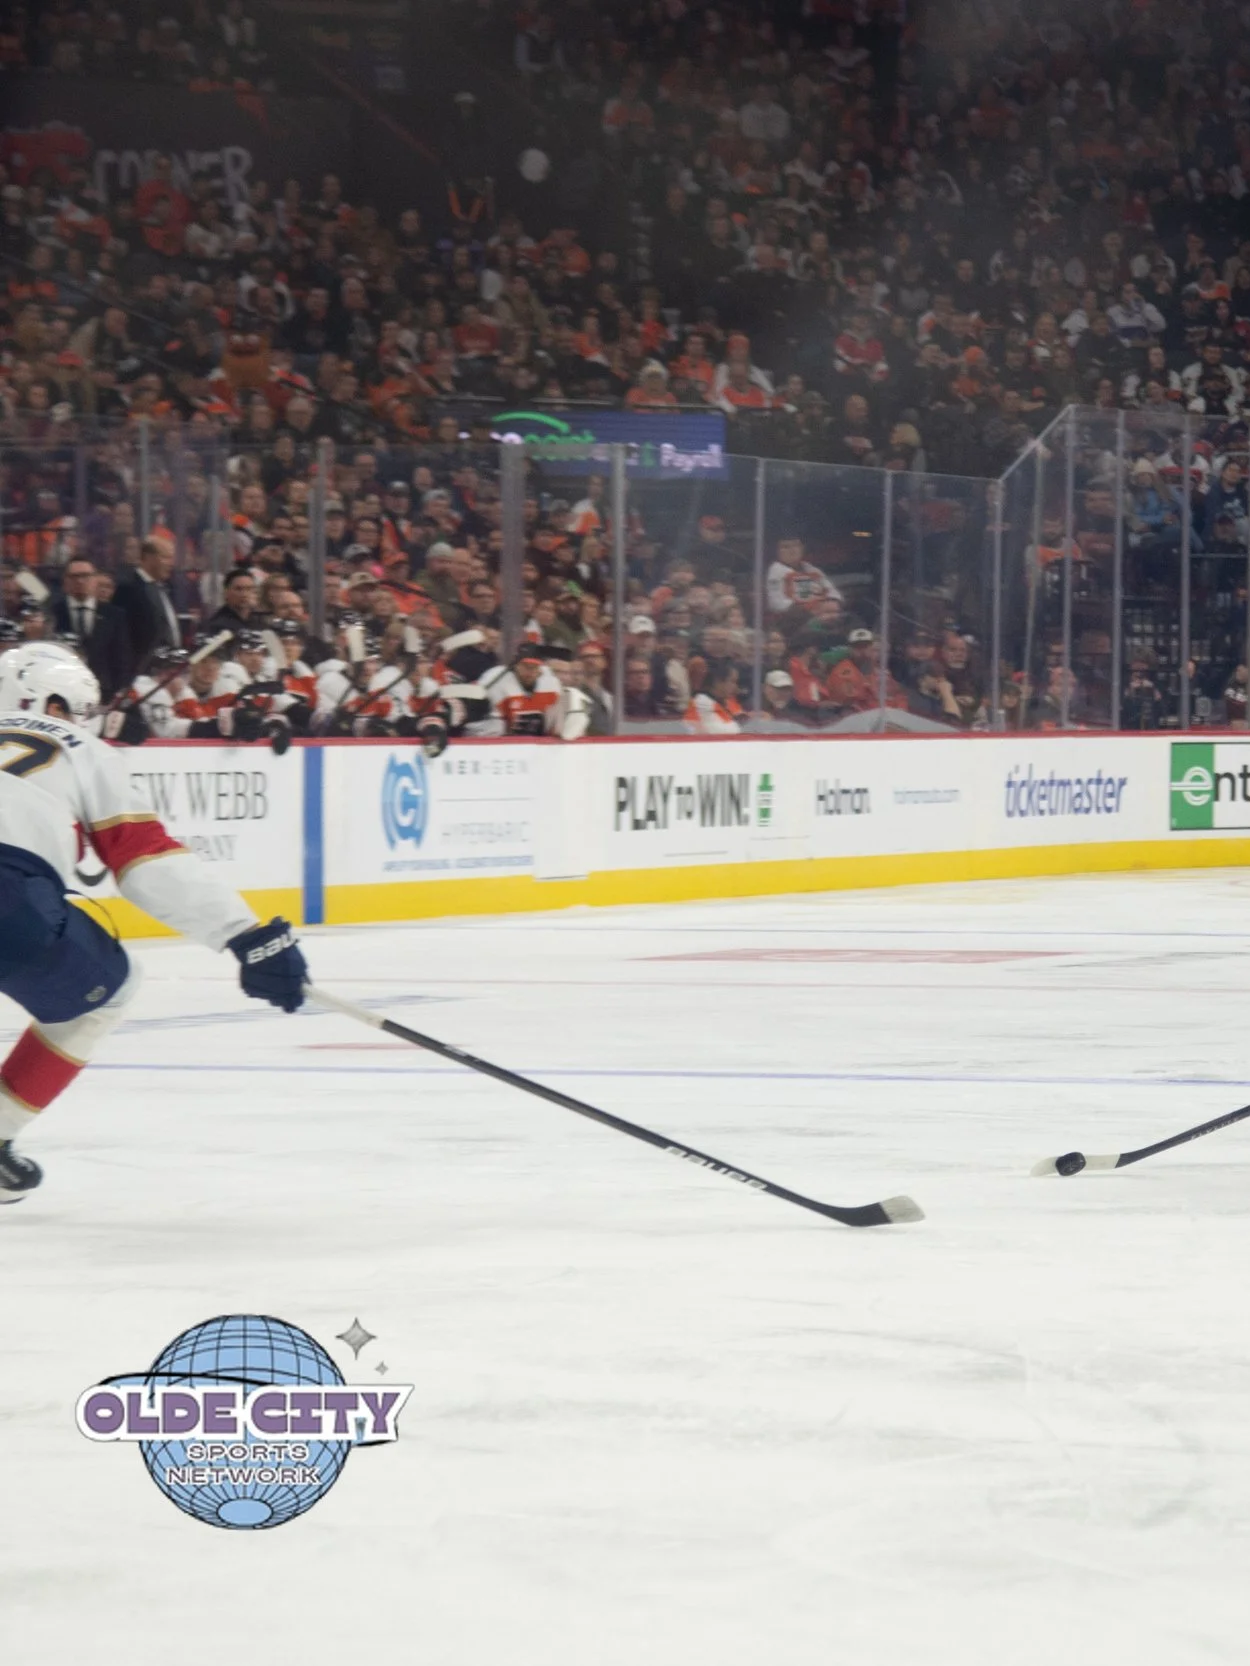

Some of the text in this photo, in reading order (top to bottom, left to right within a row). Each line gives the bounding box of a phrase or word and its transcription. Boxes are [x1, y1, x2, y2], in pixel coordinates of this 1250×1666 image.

[184, 770, 269, 821] WEBB
[614, 774, 675, 832] PLAY
[696, 772, 751, 828] WIN!
[816, 778, 872, 816] Holman
[1005, 764, 1128, 818] ticketmaster
